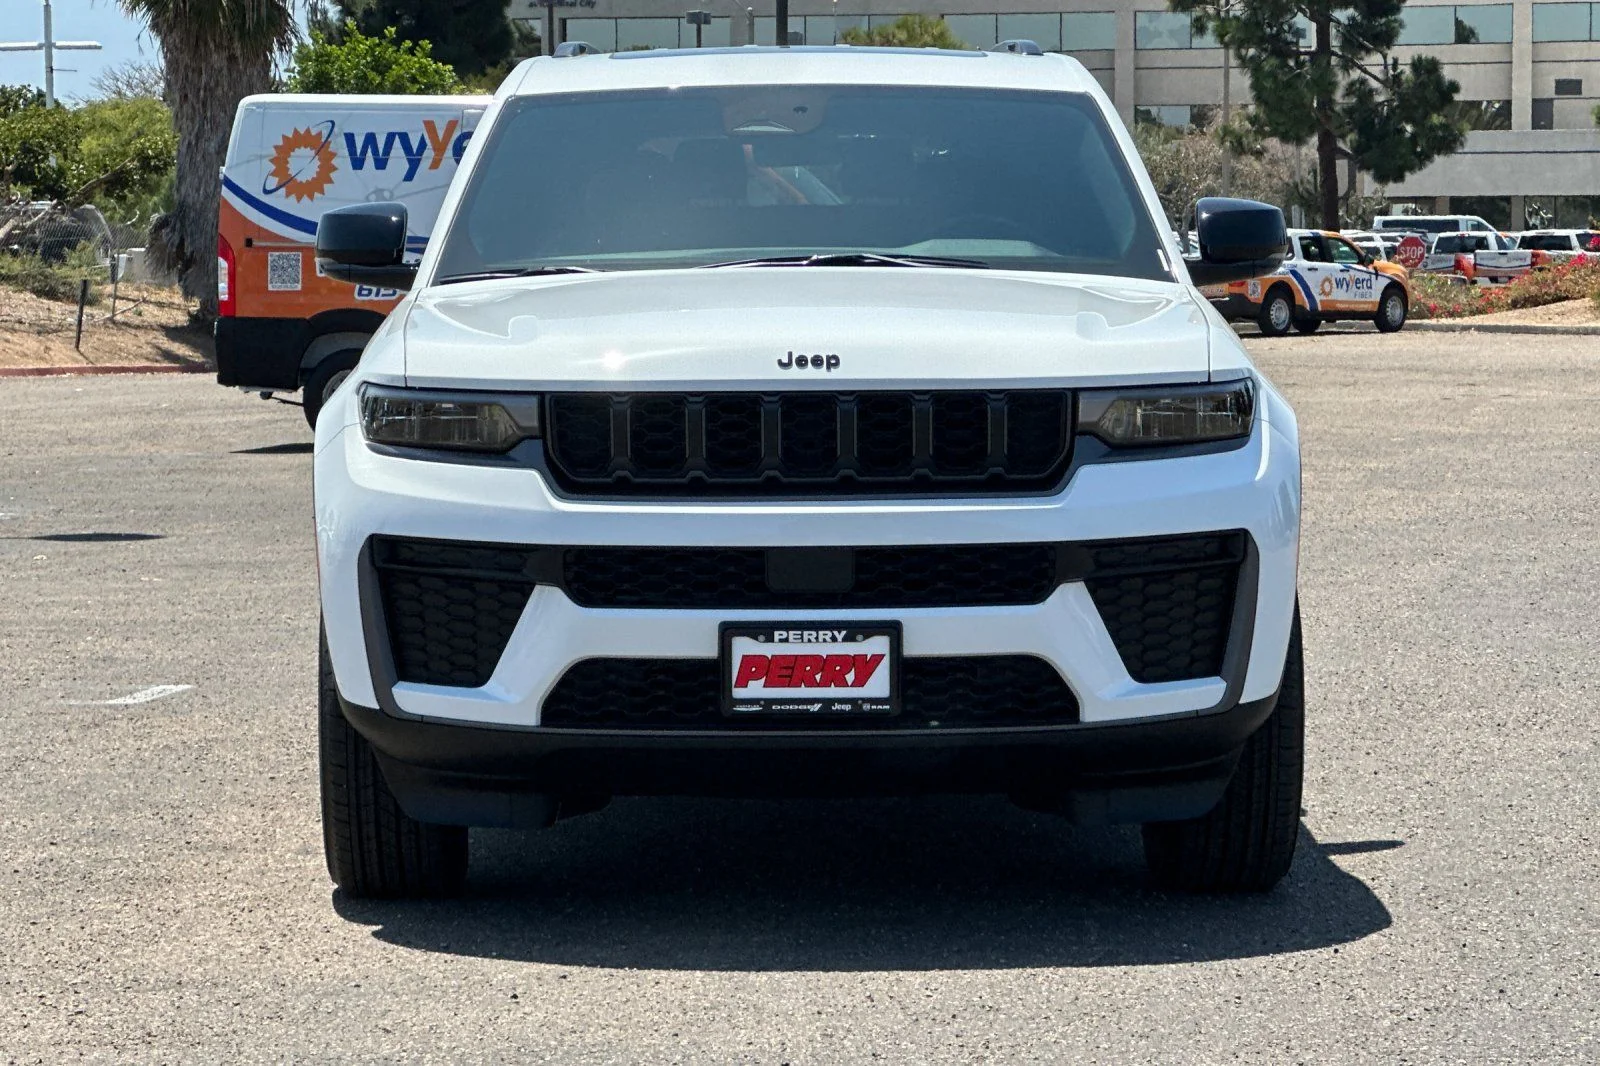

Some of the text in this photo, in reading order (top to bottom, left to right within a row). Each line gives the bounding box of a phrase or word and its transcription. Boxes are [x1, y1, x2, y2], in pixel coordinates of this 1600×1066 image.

[1400, 246, 1424, 259] STOP
[1354, 290, 1373, 299] FIBER
[777, 351, 840, 372] Jeep
[773, 630, 847, 643] PERRY
[733, 654, 886, 688] PERRY
[831, 702, 852, 711] Jeep
